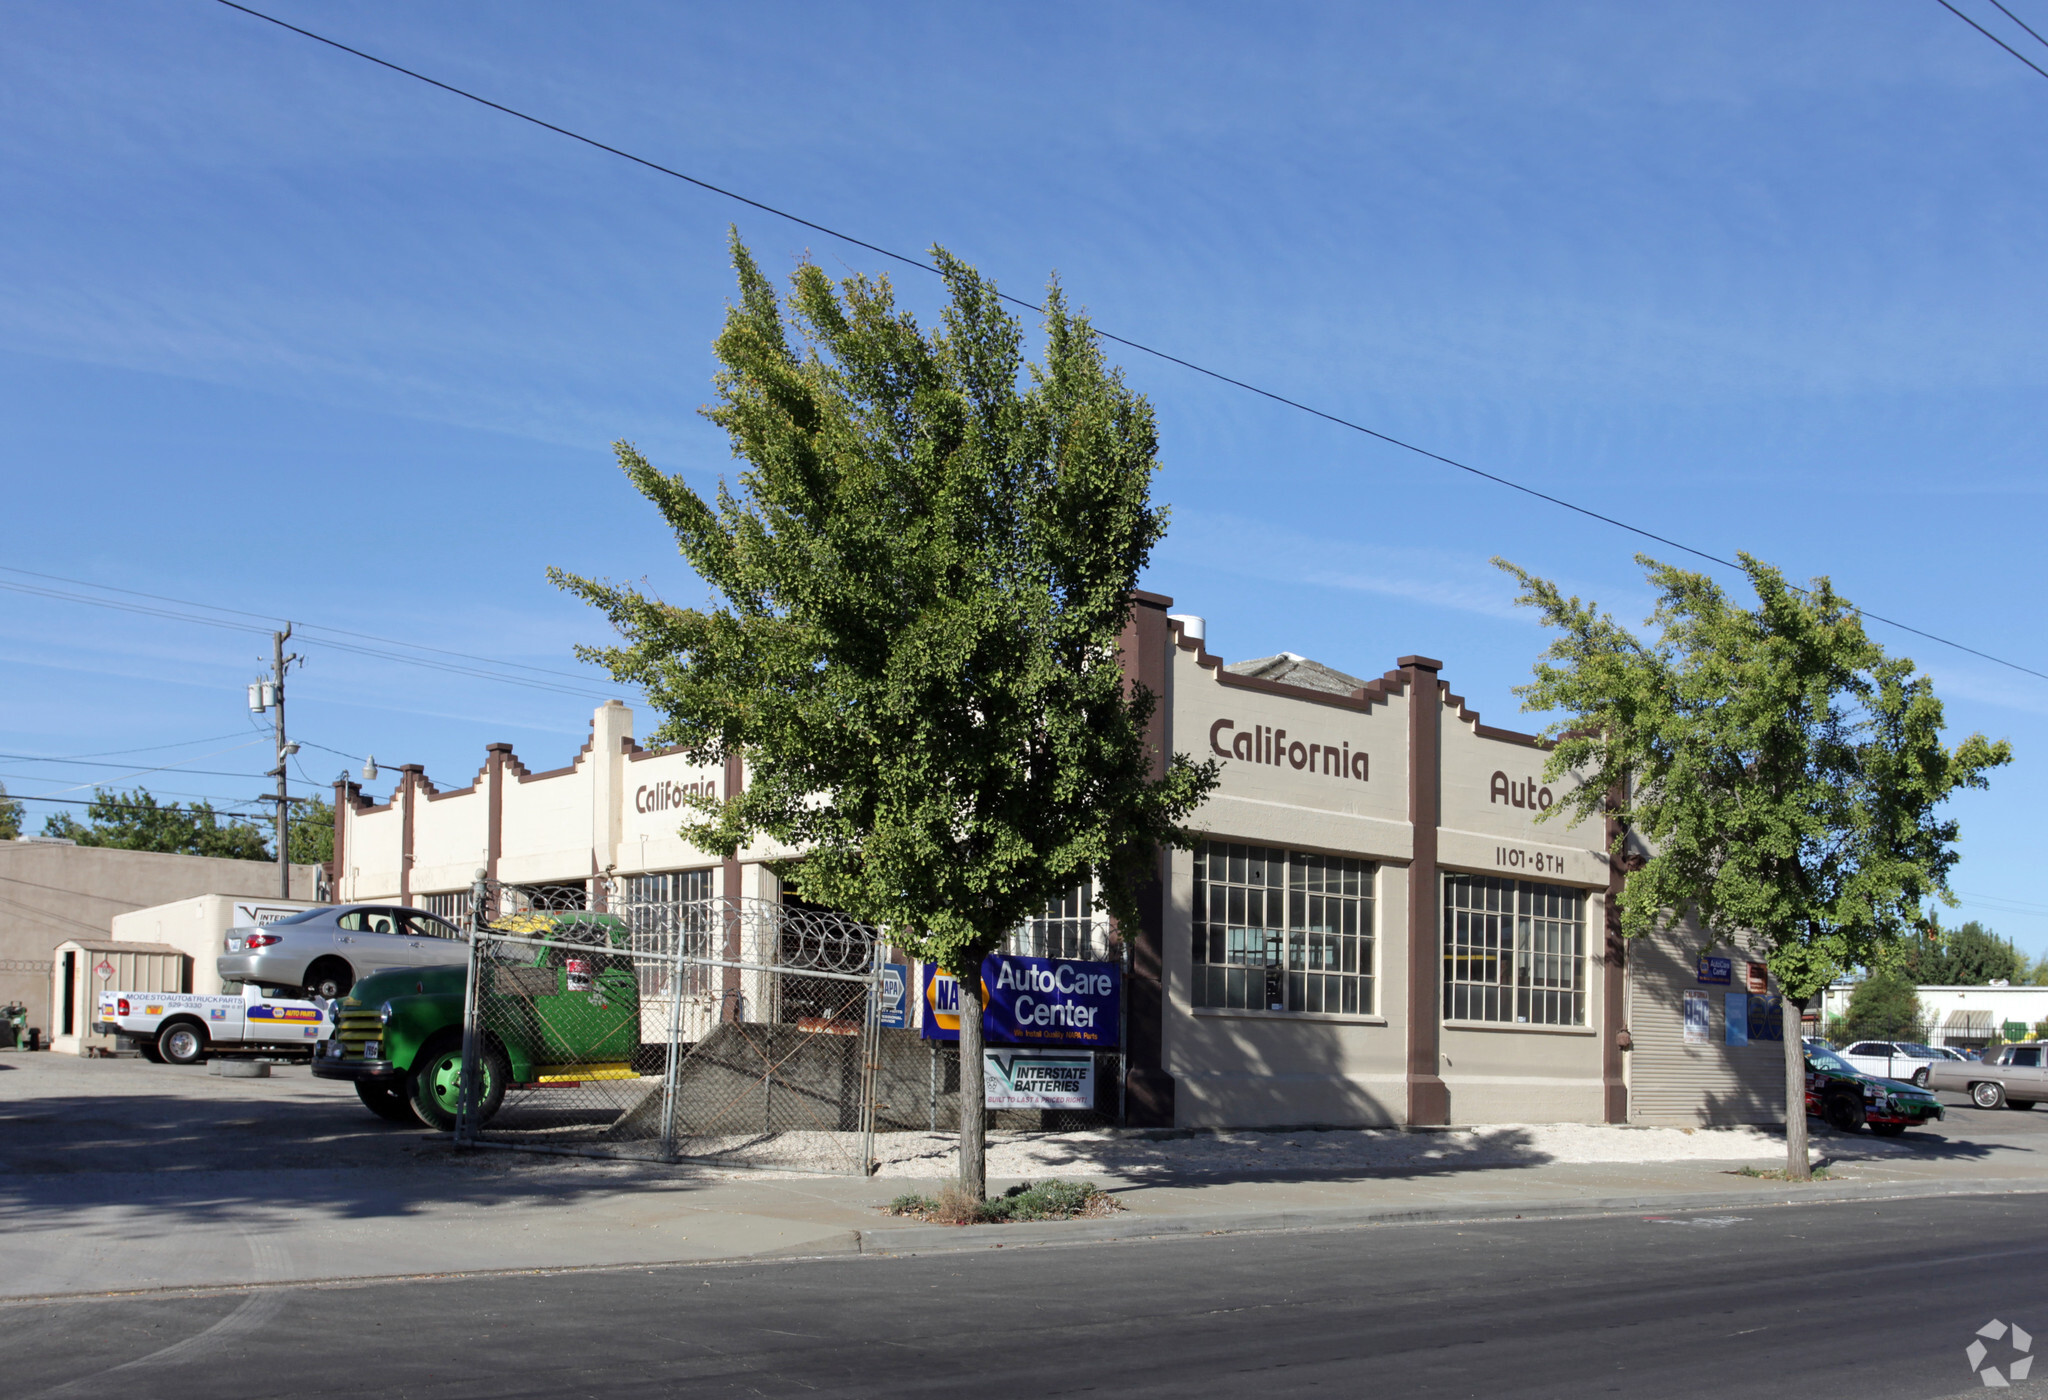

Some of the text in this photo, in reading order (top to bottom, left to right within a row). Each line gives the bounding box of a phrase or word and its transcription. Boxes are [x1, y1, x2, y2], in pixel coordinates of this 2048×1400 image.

[1209, 718, 1369, 782] California
[635, 775, 716, 814] California
[1490, 770, 1553, 812] Auto
[884, 980, 898, 995] APA
[1014, 995, 1098, 1028] Center
[1083, 1032, 1098, 1040] Parts
[1017, 1066, 1087, 1080] INTERSTATE
[1014, 1080, 1080, 1092] BATTERIES
